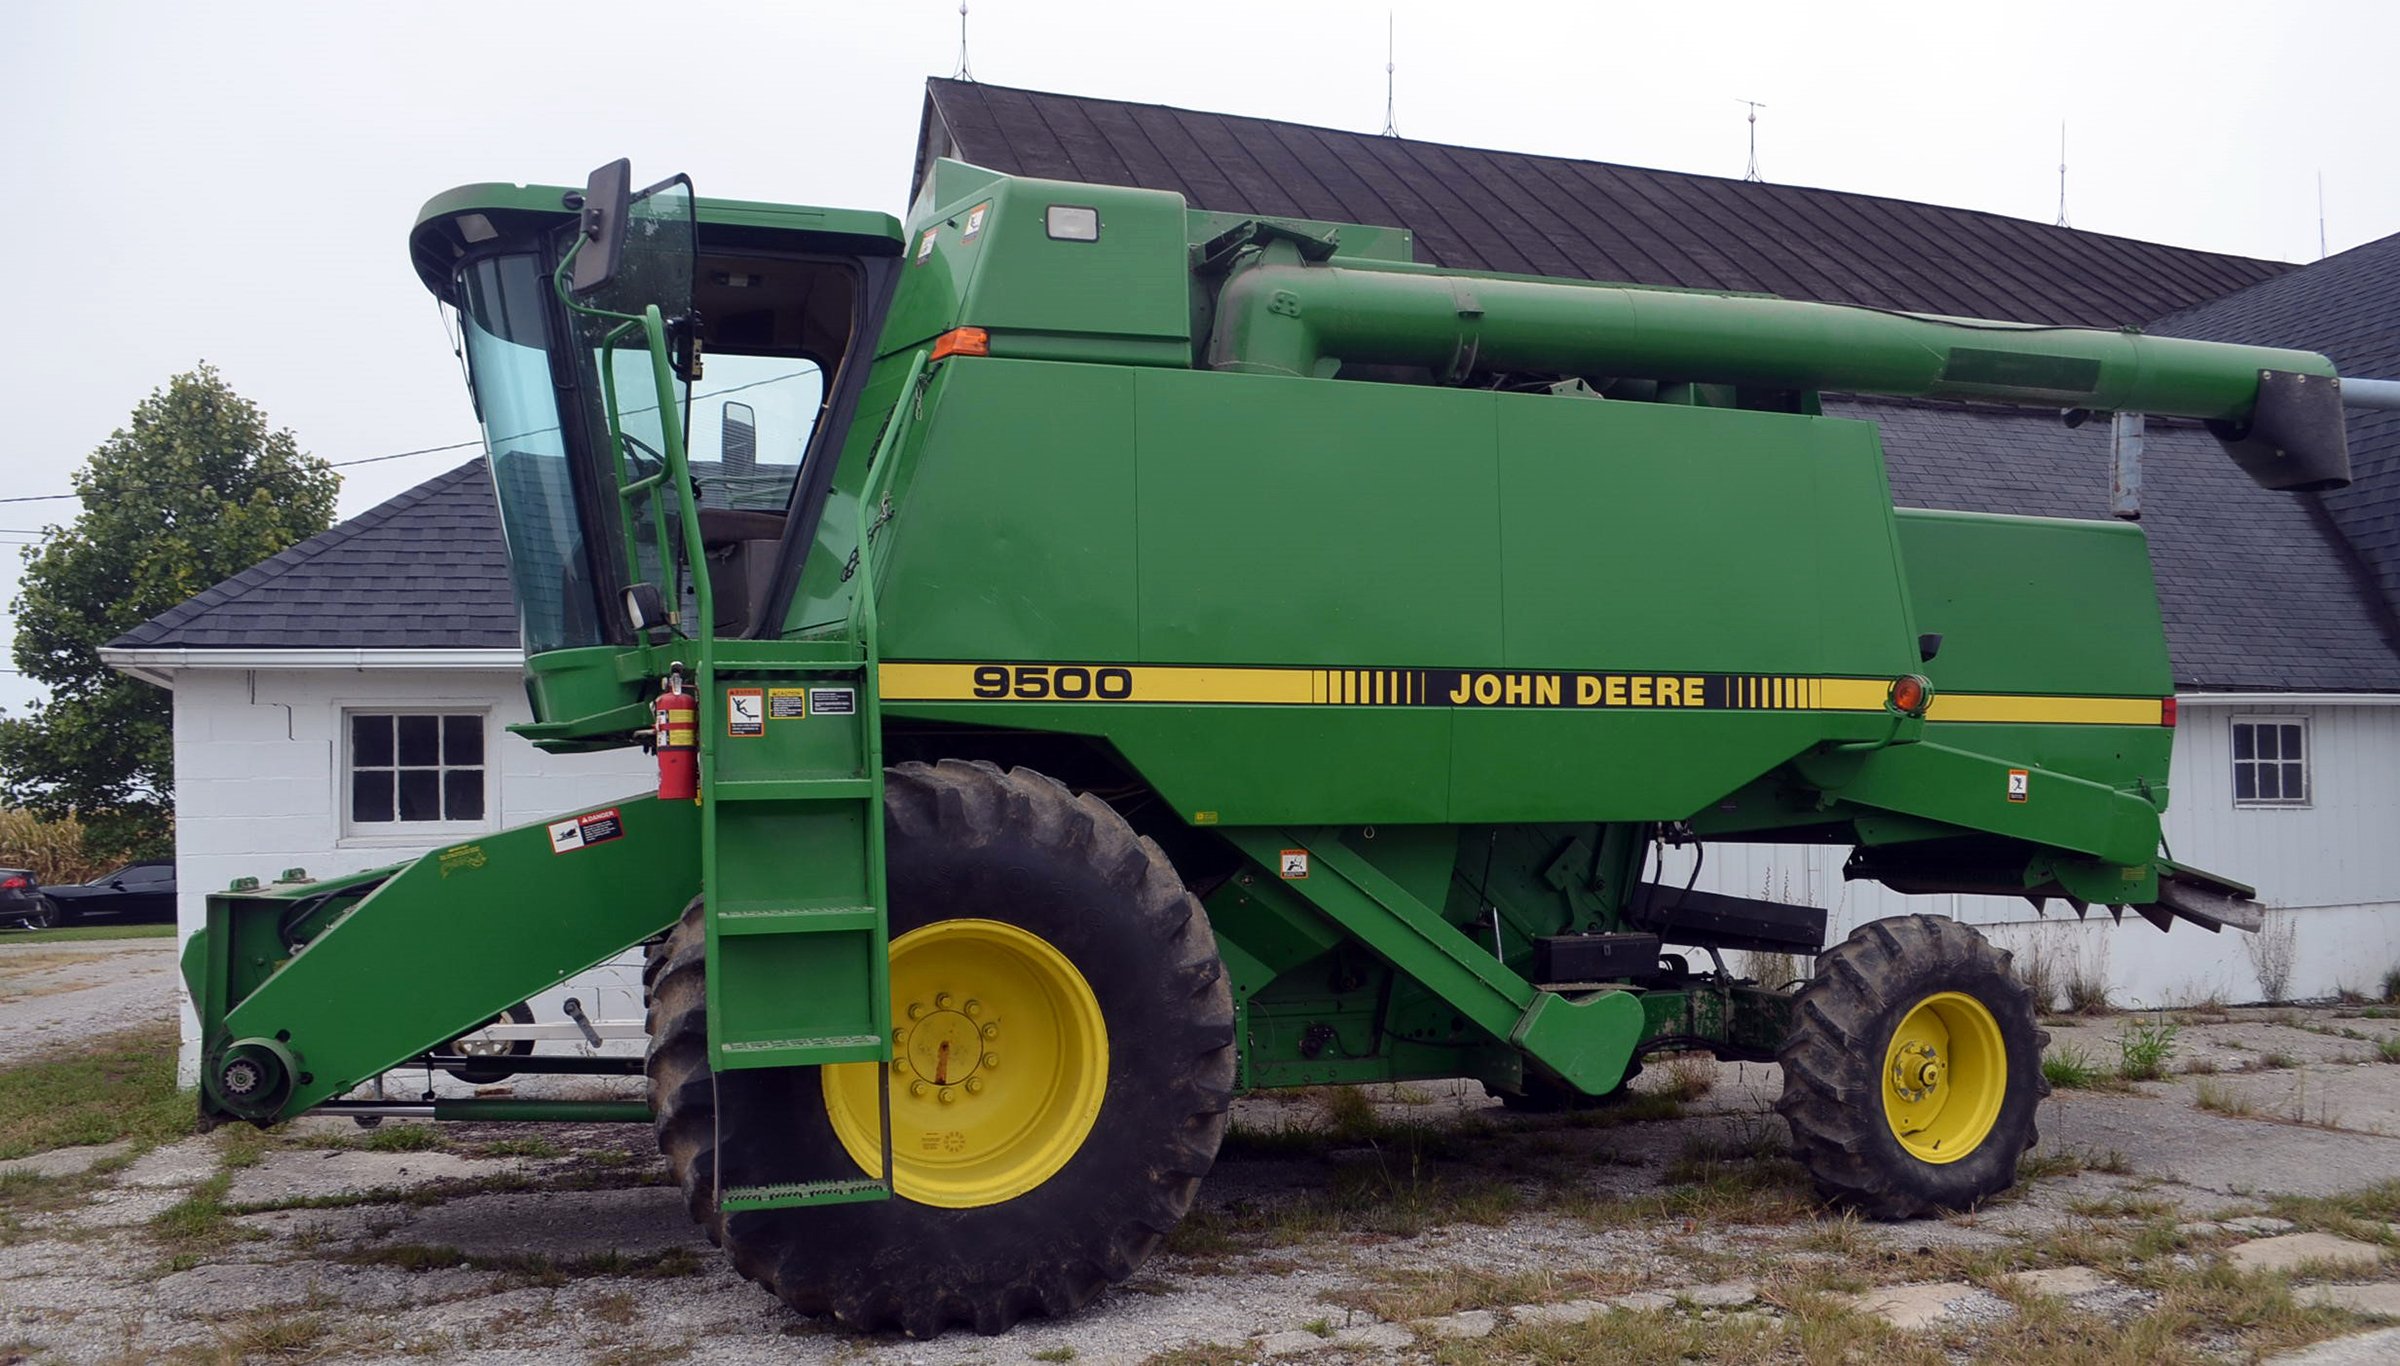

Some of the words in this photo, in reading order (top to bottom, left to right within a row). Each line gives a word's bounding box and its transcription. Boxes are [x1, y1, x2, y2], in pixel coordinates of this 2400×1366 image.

[973, 666, 1133, 699] 9500
[1450, 673, 1561, 705] JOHN
[1576, 675, 1706, 707] DEERE
[587, 810, 615, 822] DANGER
